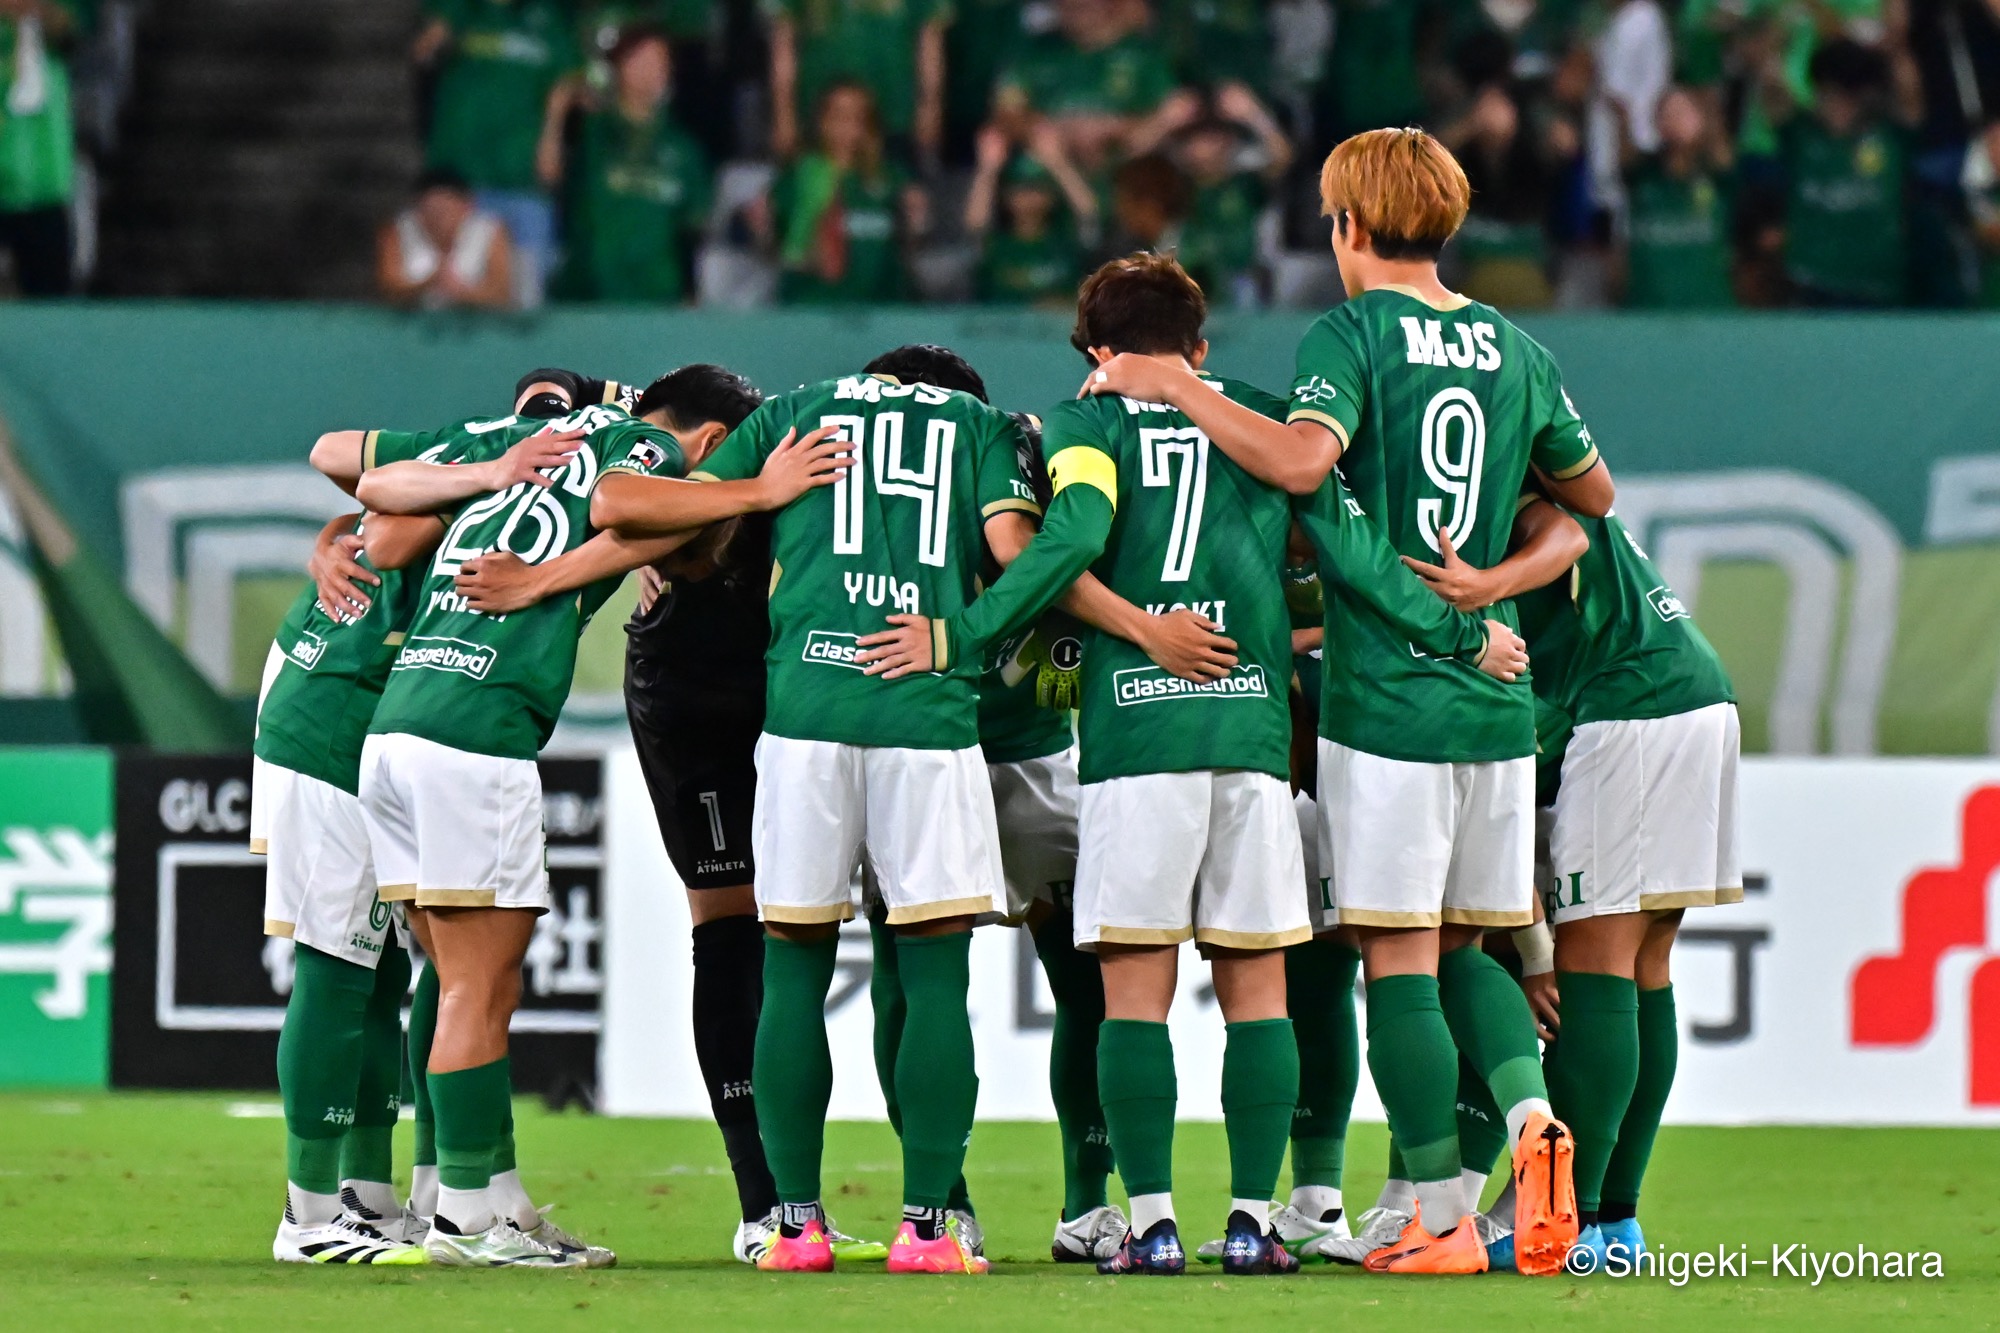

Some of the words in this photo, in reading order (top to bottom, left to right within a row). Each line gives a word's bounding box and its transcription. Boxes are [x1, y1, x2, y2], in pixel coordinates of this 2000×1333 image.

[1400, 316, 1501, 371] MJS
[820, 412, 957, 567] 14
[1417, 387, 1486, 555] 9
[1139, 427, 1210, 582] 7
[844, 571, 919, 615] YUYA
[699, 791, 726, 851] 1
[697, 861, 746, 874] ATHLETA
[1160, 1244, 1178, 1252] new
